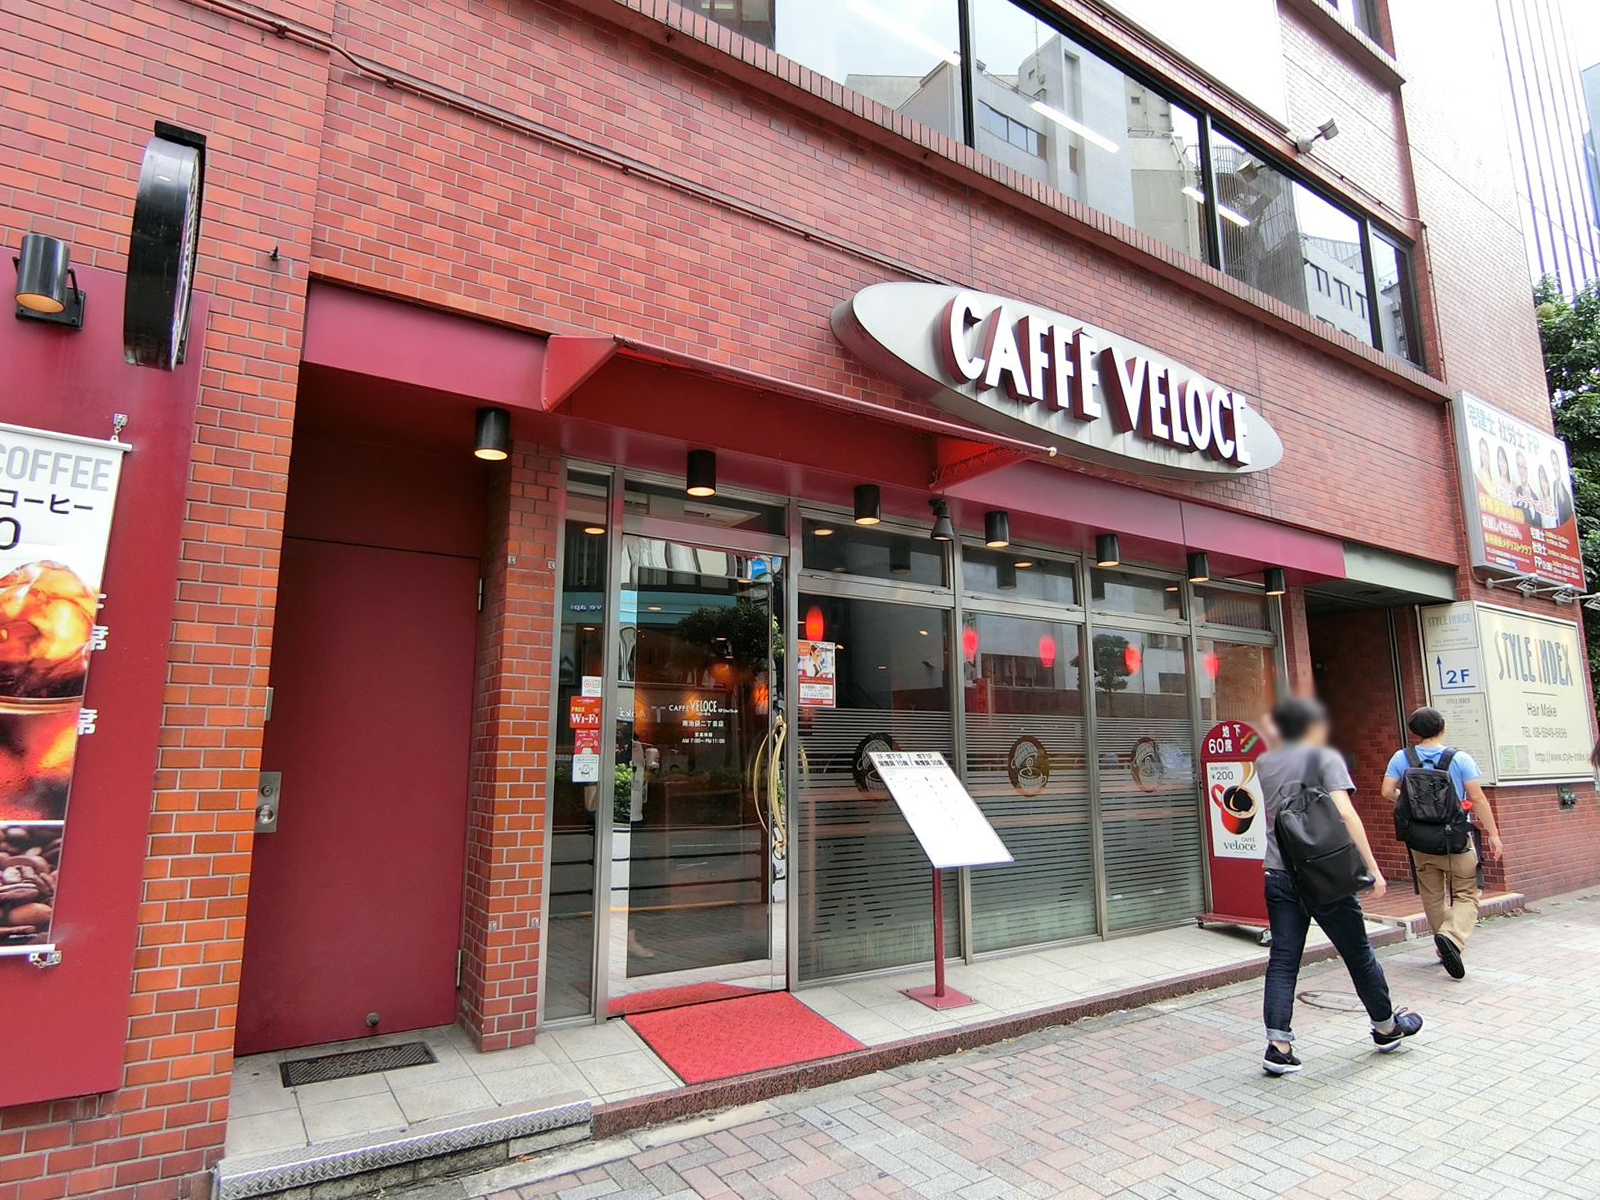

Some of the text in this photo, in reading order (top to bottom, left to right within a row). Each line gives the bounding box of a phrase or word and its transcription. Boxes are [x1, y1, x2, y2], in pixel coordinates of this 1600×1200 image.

[1102, 346, 1251, 466] VELOCE
[0, 443, 113, 492] OFFEE
[1446, 669, 1471, 684] 2F
[690, 700, 718, 713] VELOCE
[1526, 702, 1558, 718] Hair Make
[571, 714, 599, 724] Wi-Fi
[1222, 724, 1241, 738] 地下
[1208, 738, 1233, 754] 60席
[1223, 840, 1257, 851] veloce
